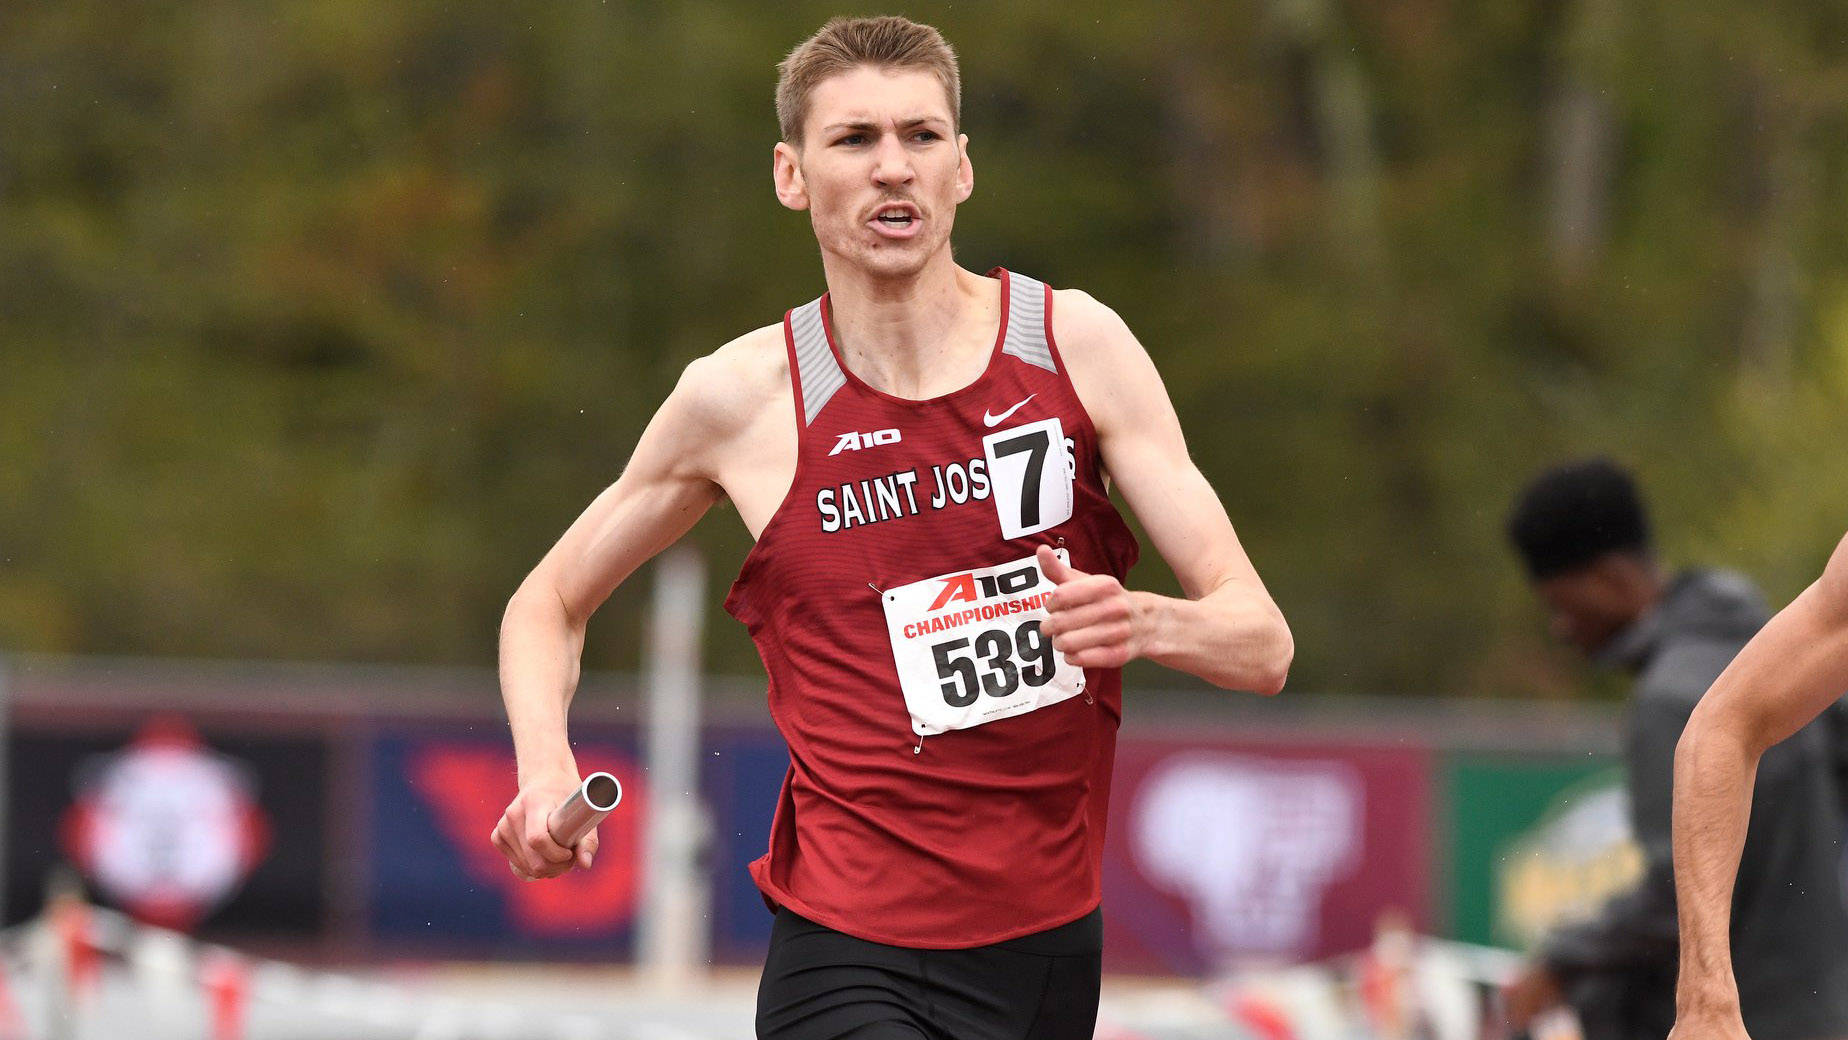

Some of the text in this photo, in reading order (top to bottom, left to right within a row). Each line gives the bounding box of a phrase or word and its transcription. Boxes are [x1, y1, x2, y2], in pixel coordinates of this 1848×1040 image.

[827, 428, 901, 456] A10
[816, 468, 919, 533] SAINT
[993, 430, 1049, 528] 7
[927, 566, 1039, 612] A10
[931, 620, 1056, 708] 539
